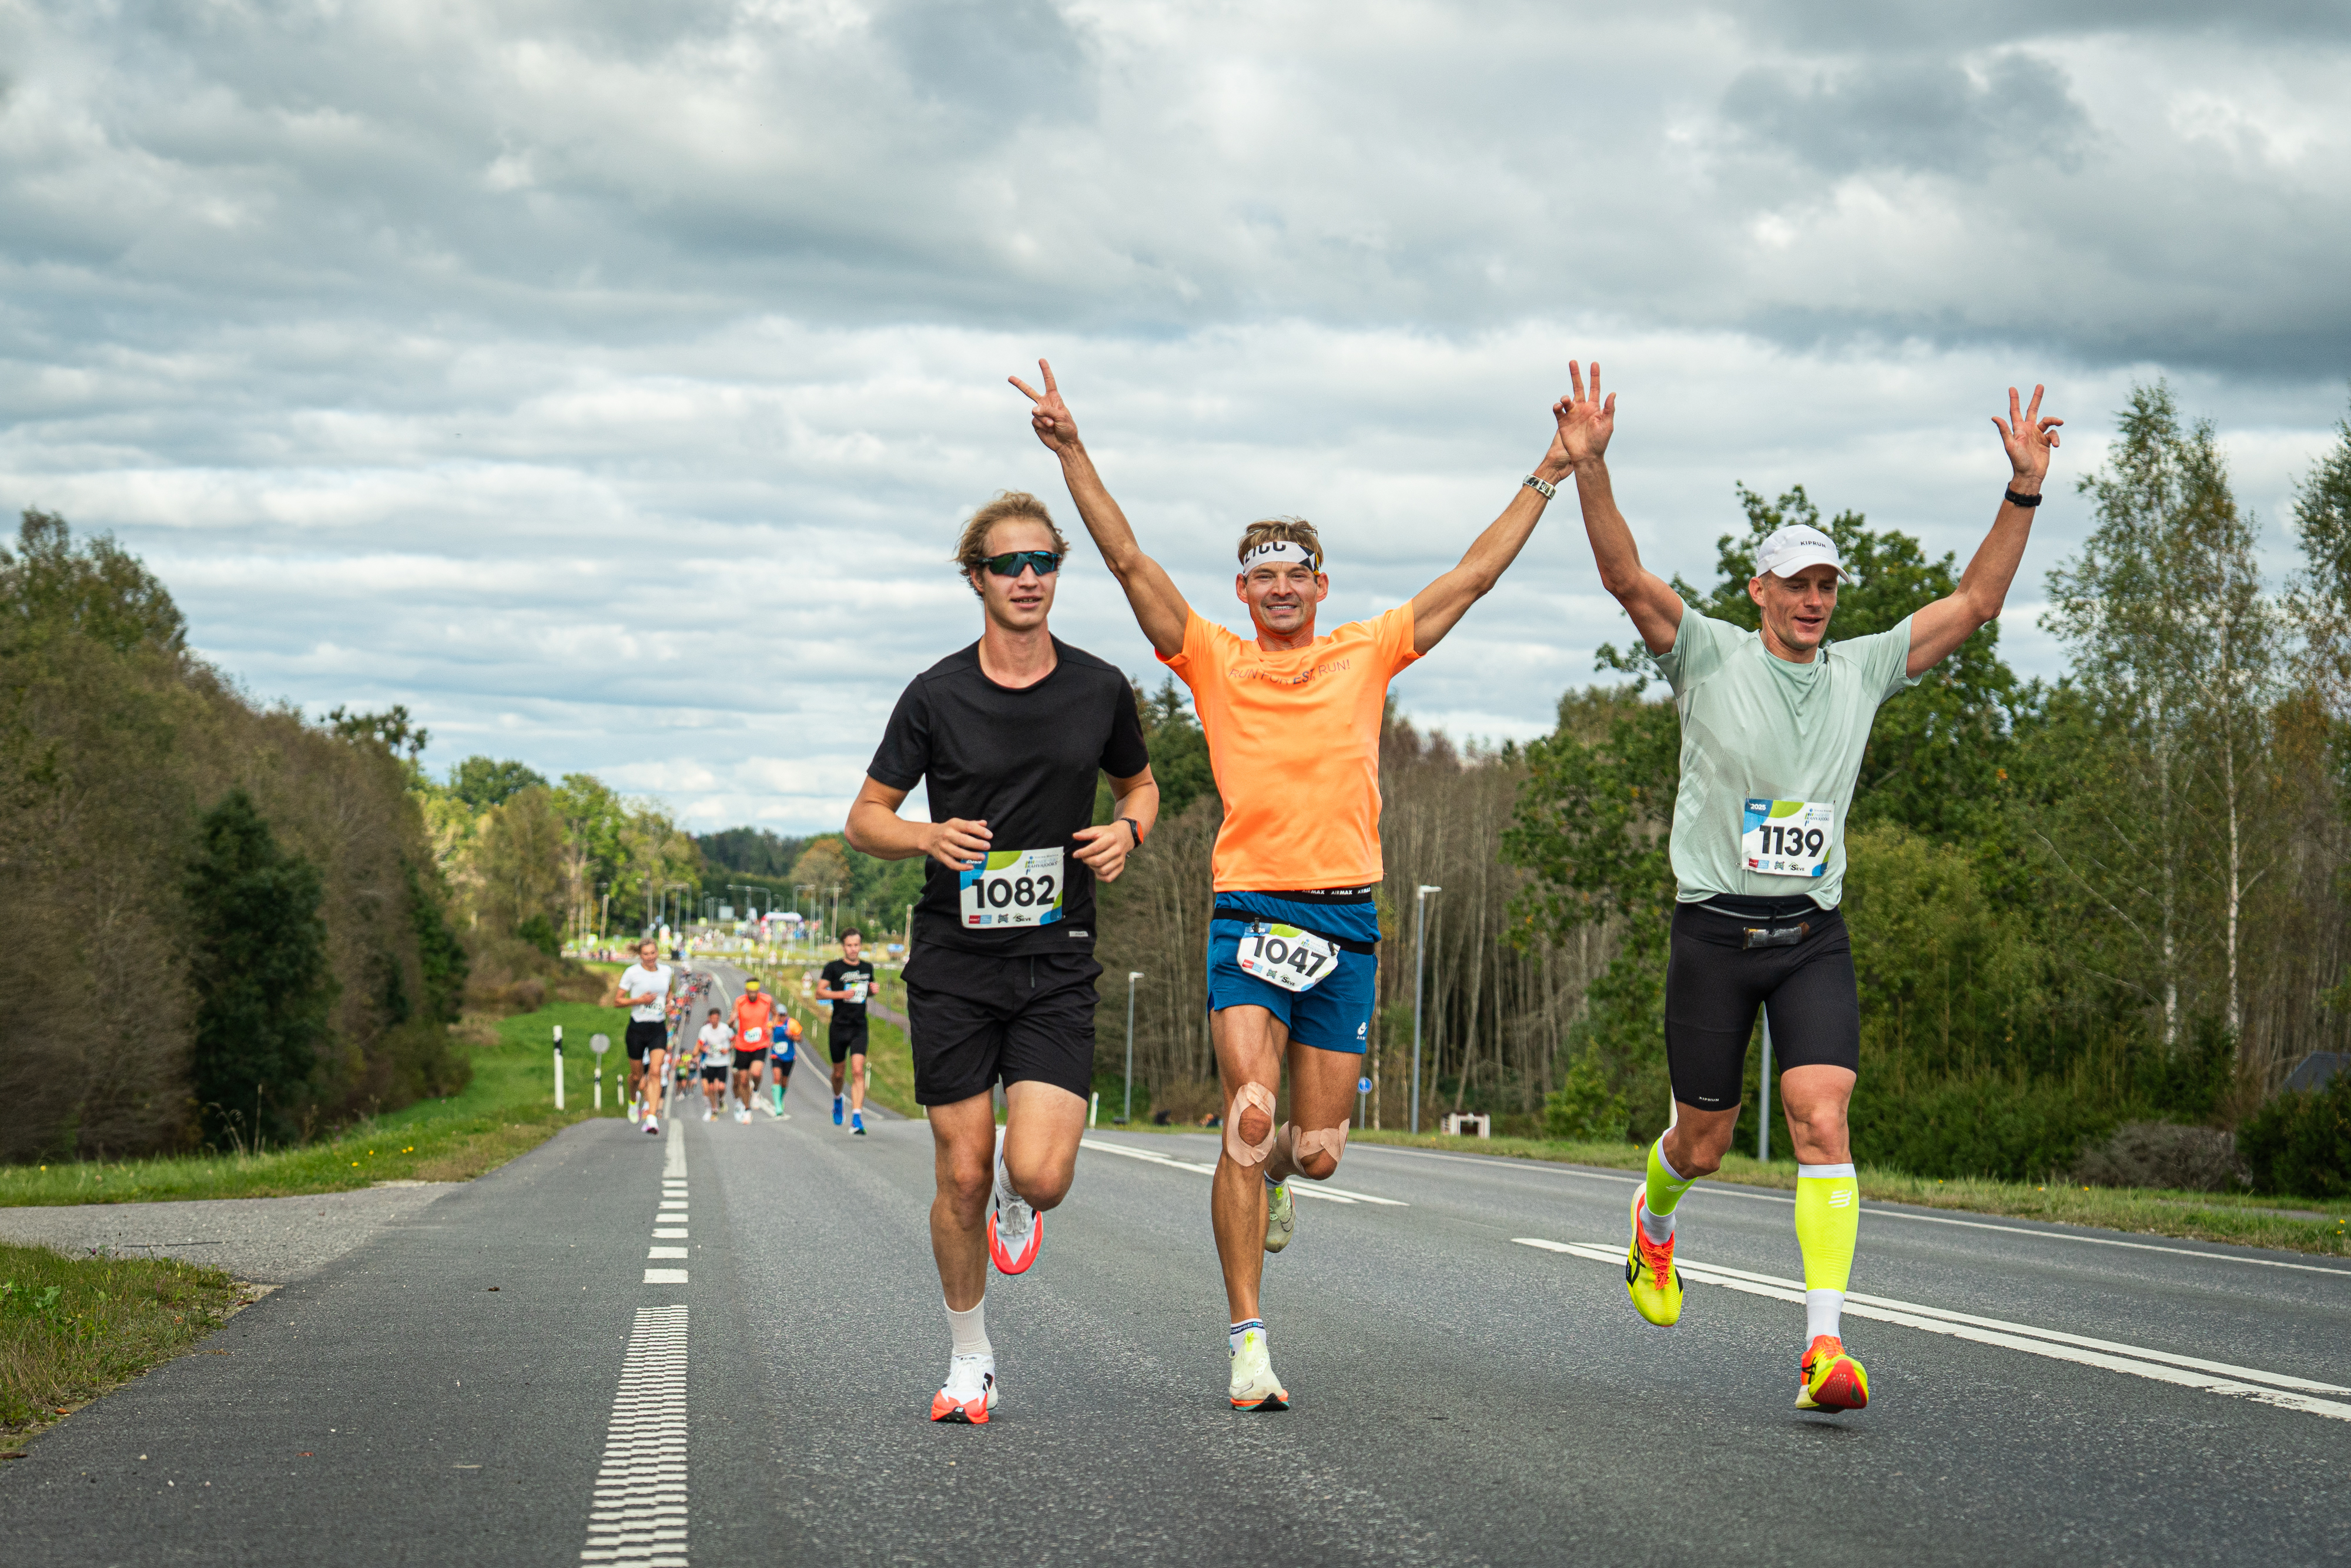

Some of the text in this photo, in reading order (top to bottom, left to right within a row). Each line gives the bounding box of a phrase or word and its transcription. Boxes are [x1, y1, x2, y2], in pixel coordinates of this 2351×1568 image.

[1228, 668, 1258, 679] RUN
[1318, 659, 1351, 676] RUN!
[1759, 825, 1824, 857] 1139
[972, 875, 1055, 909] 1082
[1254, 936, 1328, 978] 1047
[1281, 976, 1296, 986] SEVE
